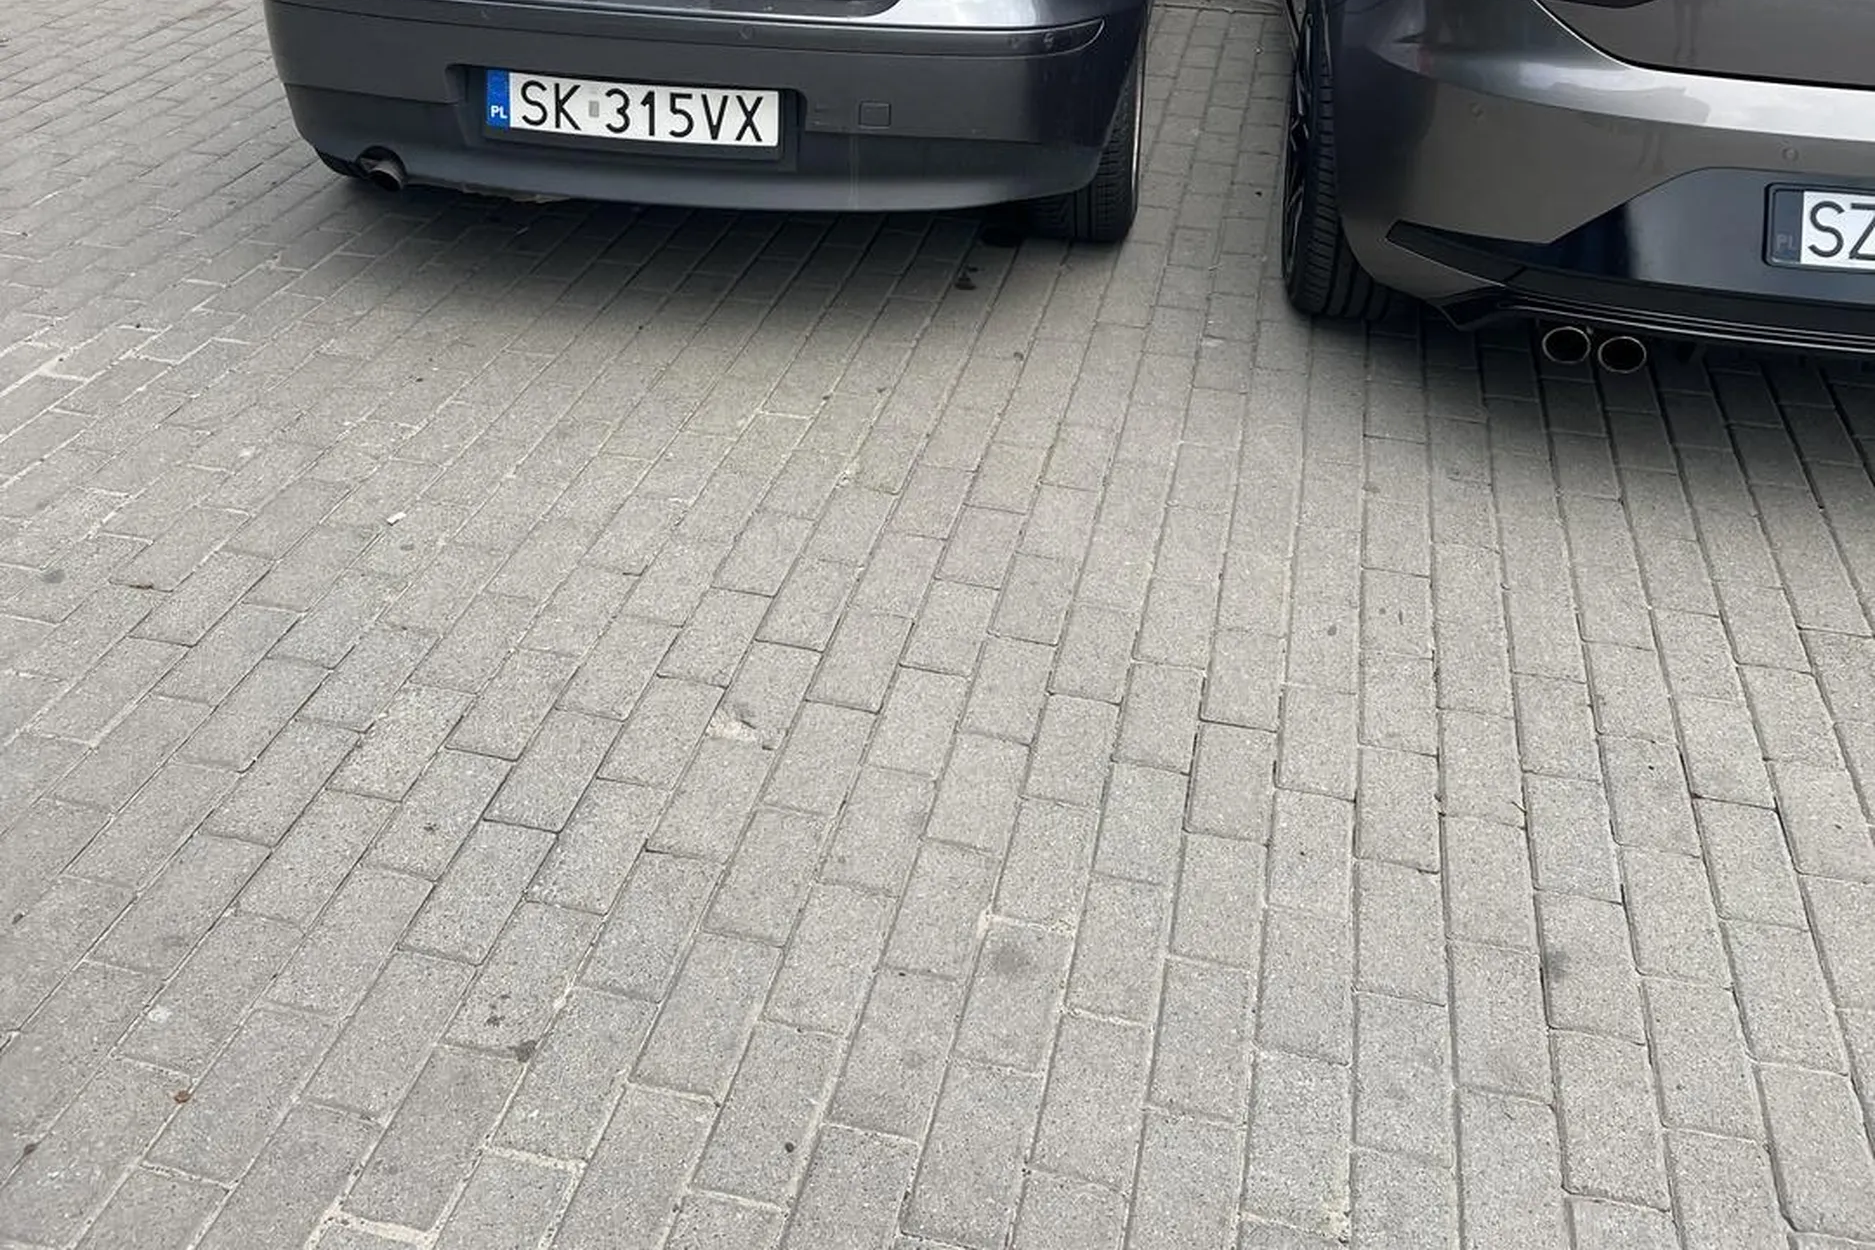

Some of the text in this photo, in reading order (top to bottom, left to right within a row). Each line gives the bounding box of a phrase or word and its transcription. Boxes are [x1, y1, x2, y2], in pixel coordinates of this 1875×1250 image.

[490, 105, 508, 119] PL
[520, 80, 764, 142] SK 315VX
[1808, 200, 1875, 260] SZ
